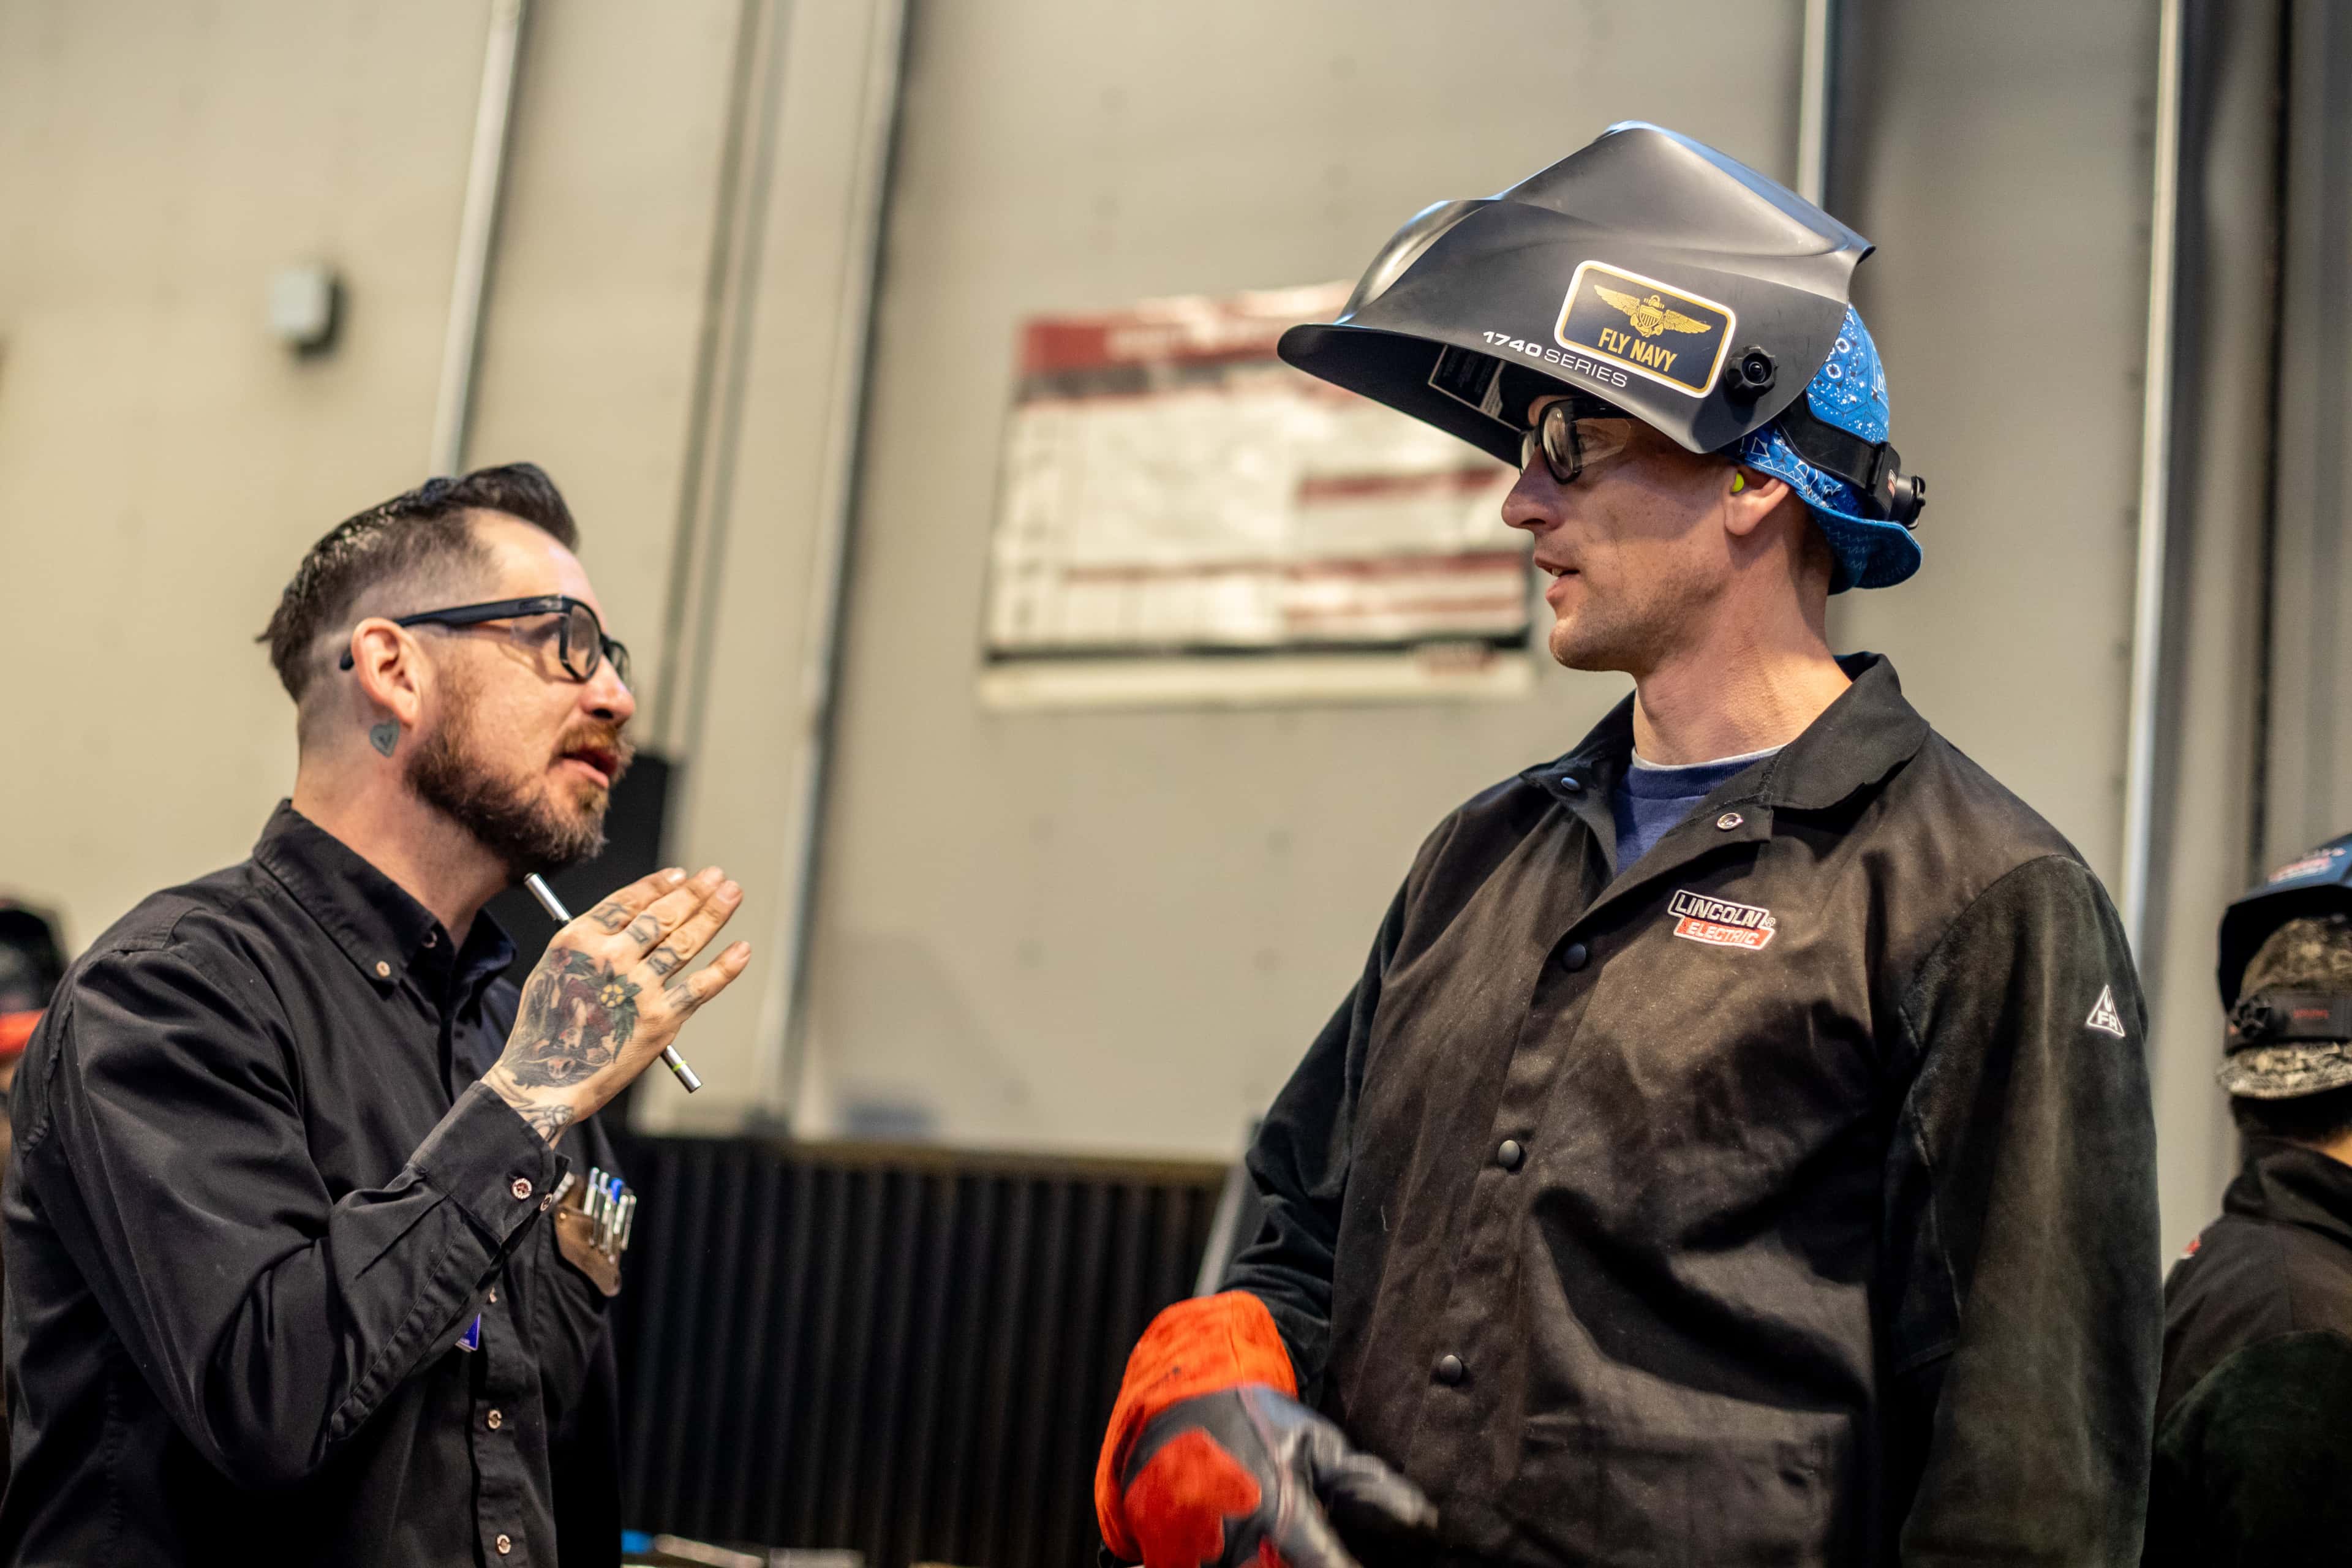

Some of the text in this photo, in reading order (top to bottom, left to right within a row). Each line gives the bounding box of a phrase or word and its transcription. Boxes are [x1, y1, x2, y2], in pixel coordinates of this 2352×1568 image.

[1483, 331, 1627, 388] 1740 SERIES
[1598, 327, 1678, 372] FLY NAVY
[1675, 894, 1762, 928] LINCOLN
[1686, 921, 1759, 944] ELECTRIC
